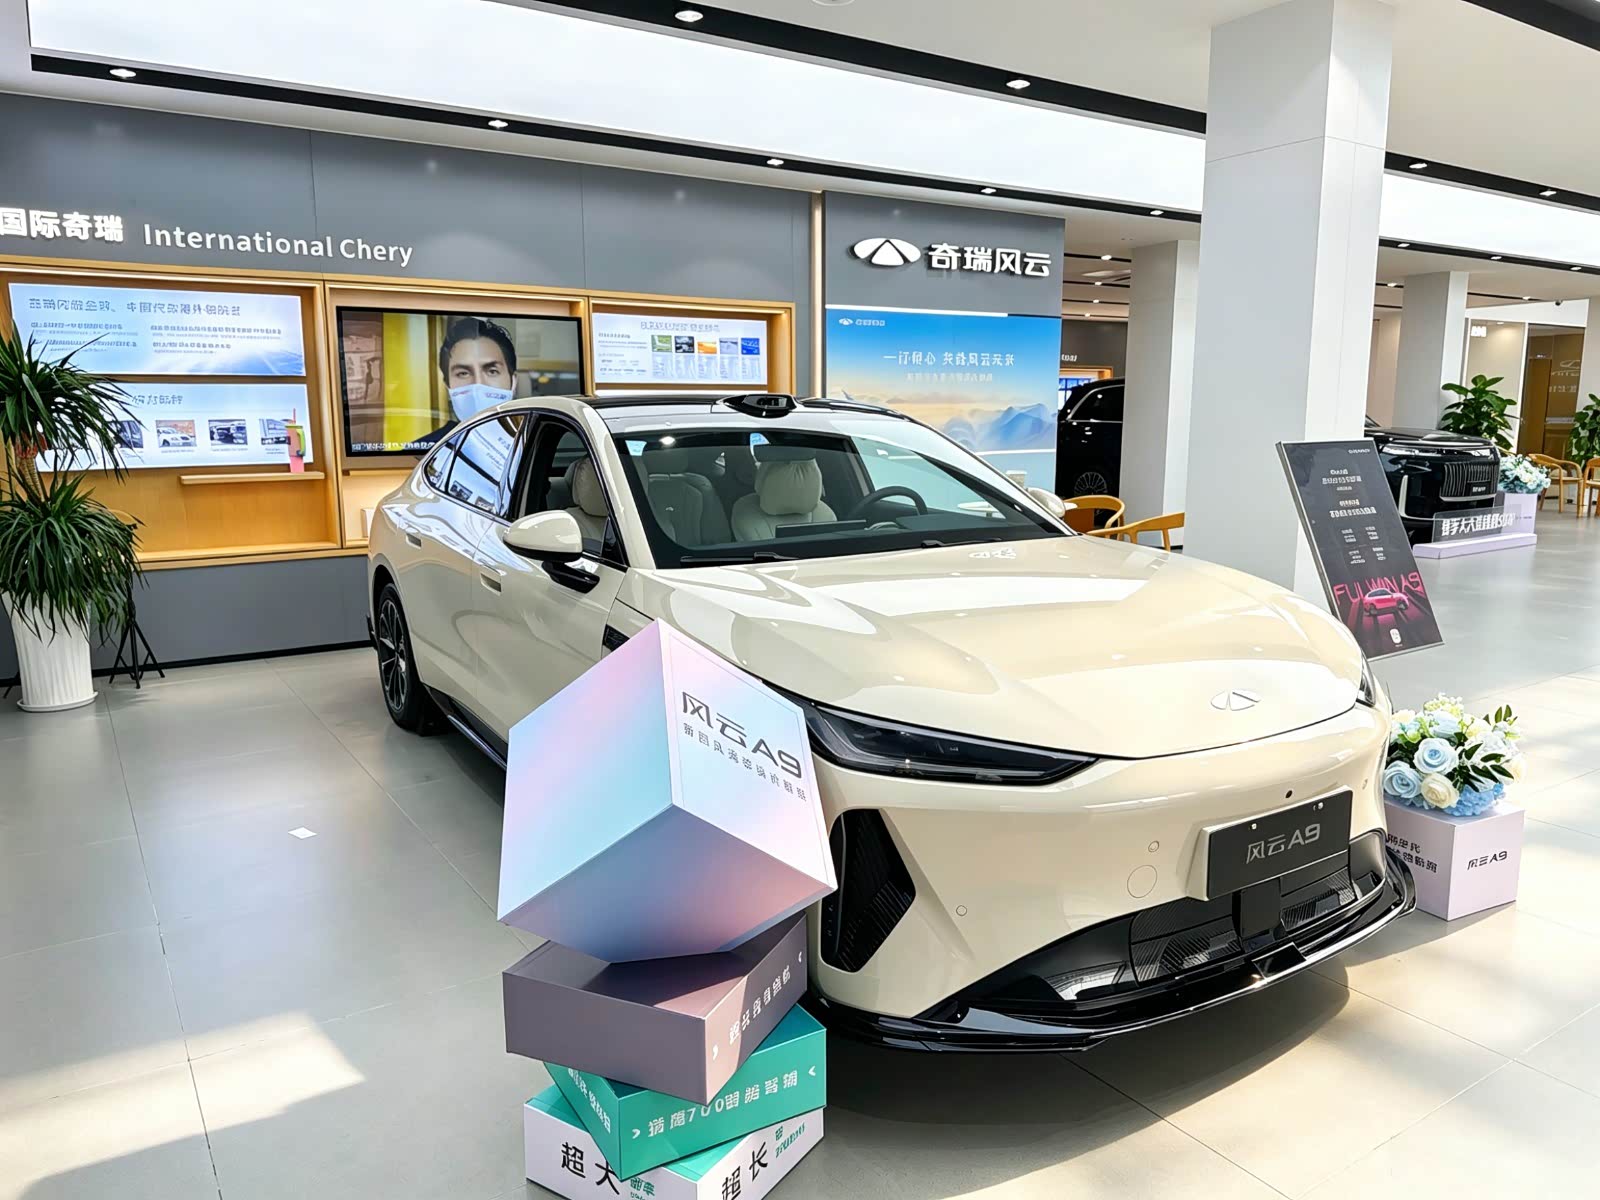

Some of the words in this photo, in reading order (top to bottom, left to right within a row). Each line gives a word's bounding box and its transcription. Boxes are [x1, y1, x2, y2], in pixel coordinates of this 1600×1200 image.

[0, 207, 124, 243] 国际奇瑞
[143, 224, 334, 259] International
[339, 238, 413, 267] Chery
[928, 242, 1051, 277] 奇瑞风云
[682, 691, 802, 779] 风云A9
[1246, 823, 1320, 864] 风云A9
[561, 1142, 620, 1195] 超大
